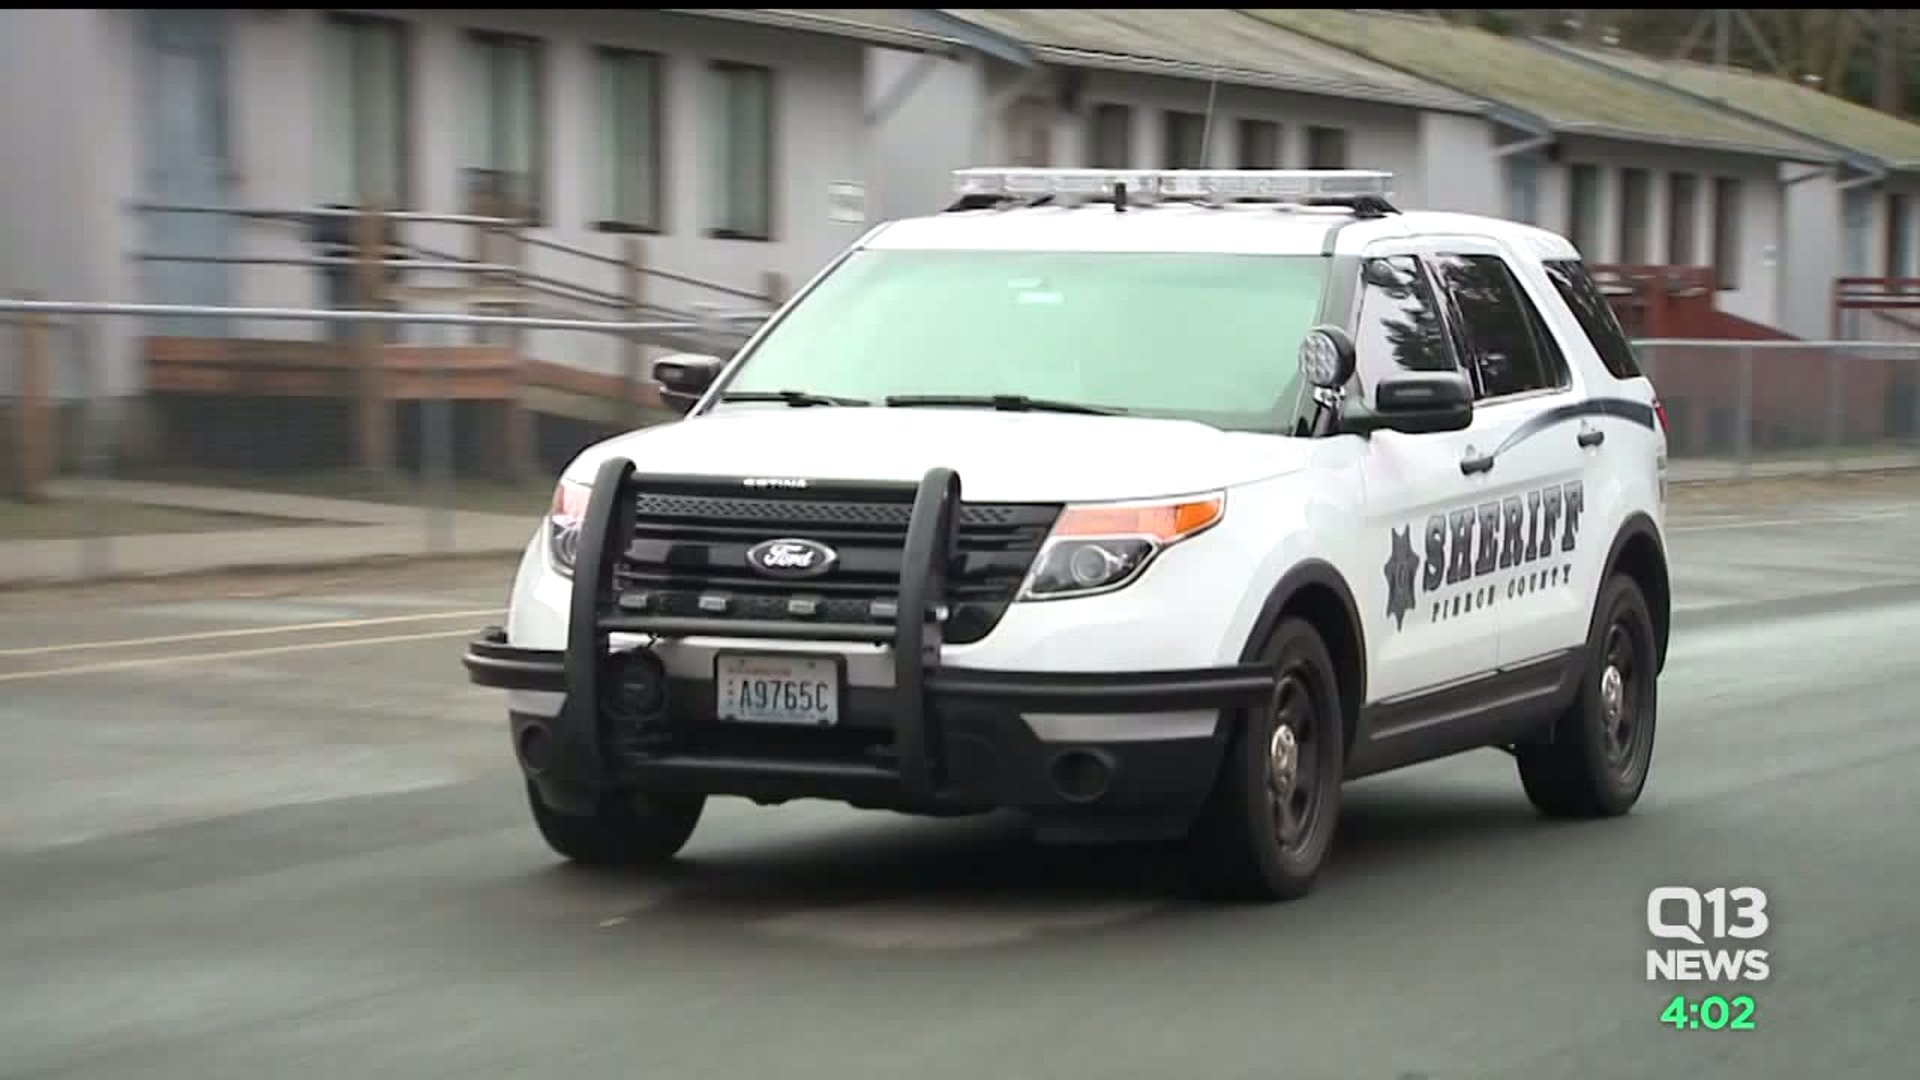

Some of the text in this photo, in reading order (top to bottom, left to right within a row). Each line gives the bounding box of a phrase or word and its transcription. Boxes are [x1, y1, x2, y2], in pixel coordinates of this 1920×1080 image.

[763, 543, 815, 568] Ford
[1422, 479, 1584, 593] SHERIFF
[1431, 563, 1572, 623] PIERCE COUNTY
[740, 679, 829, 713] A9765C
